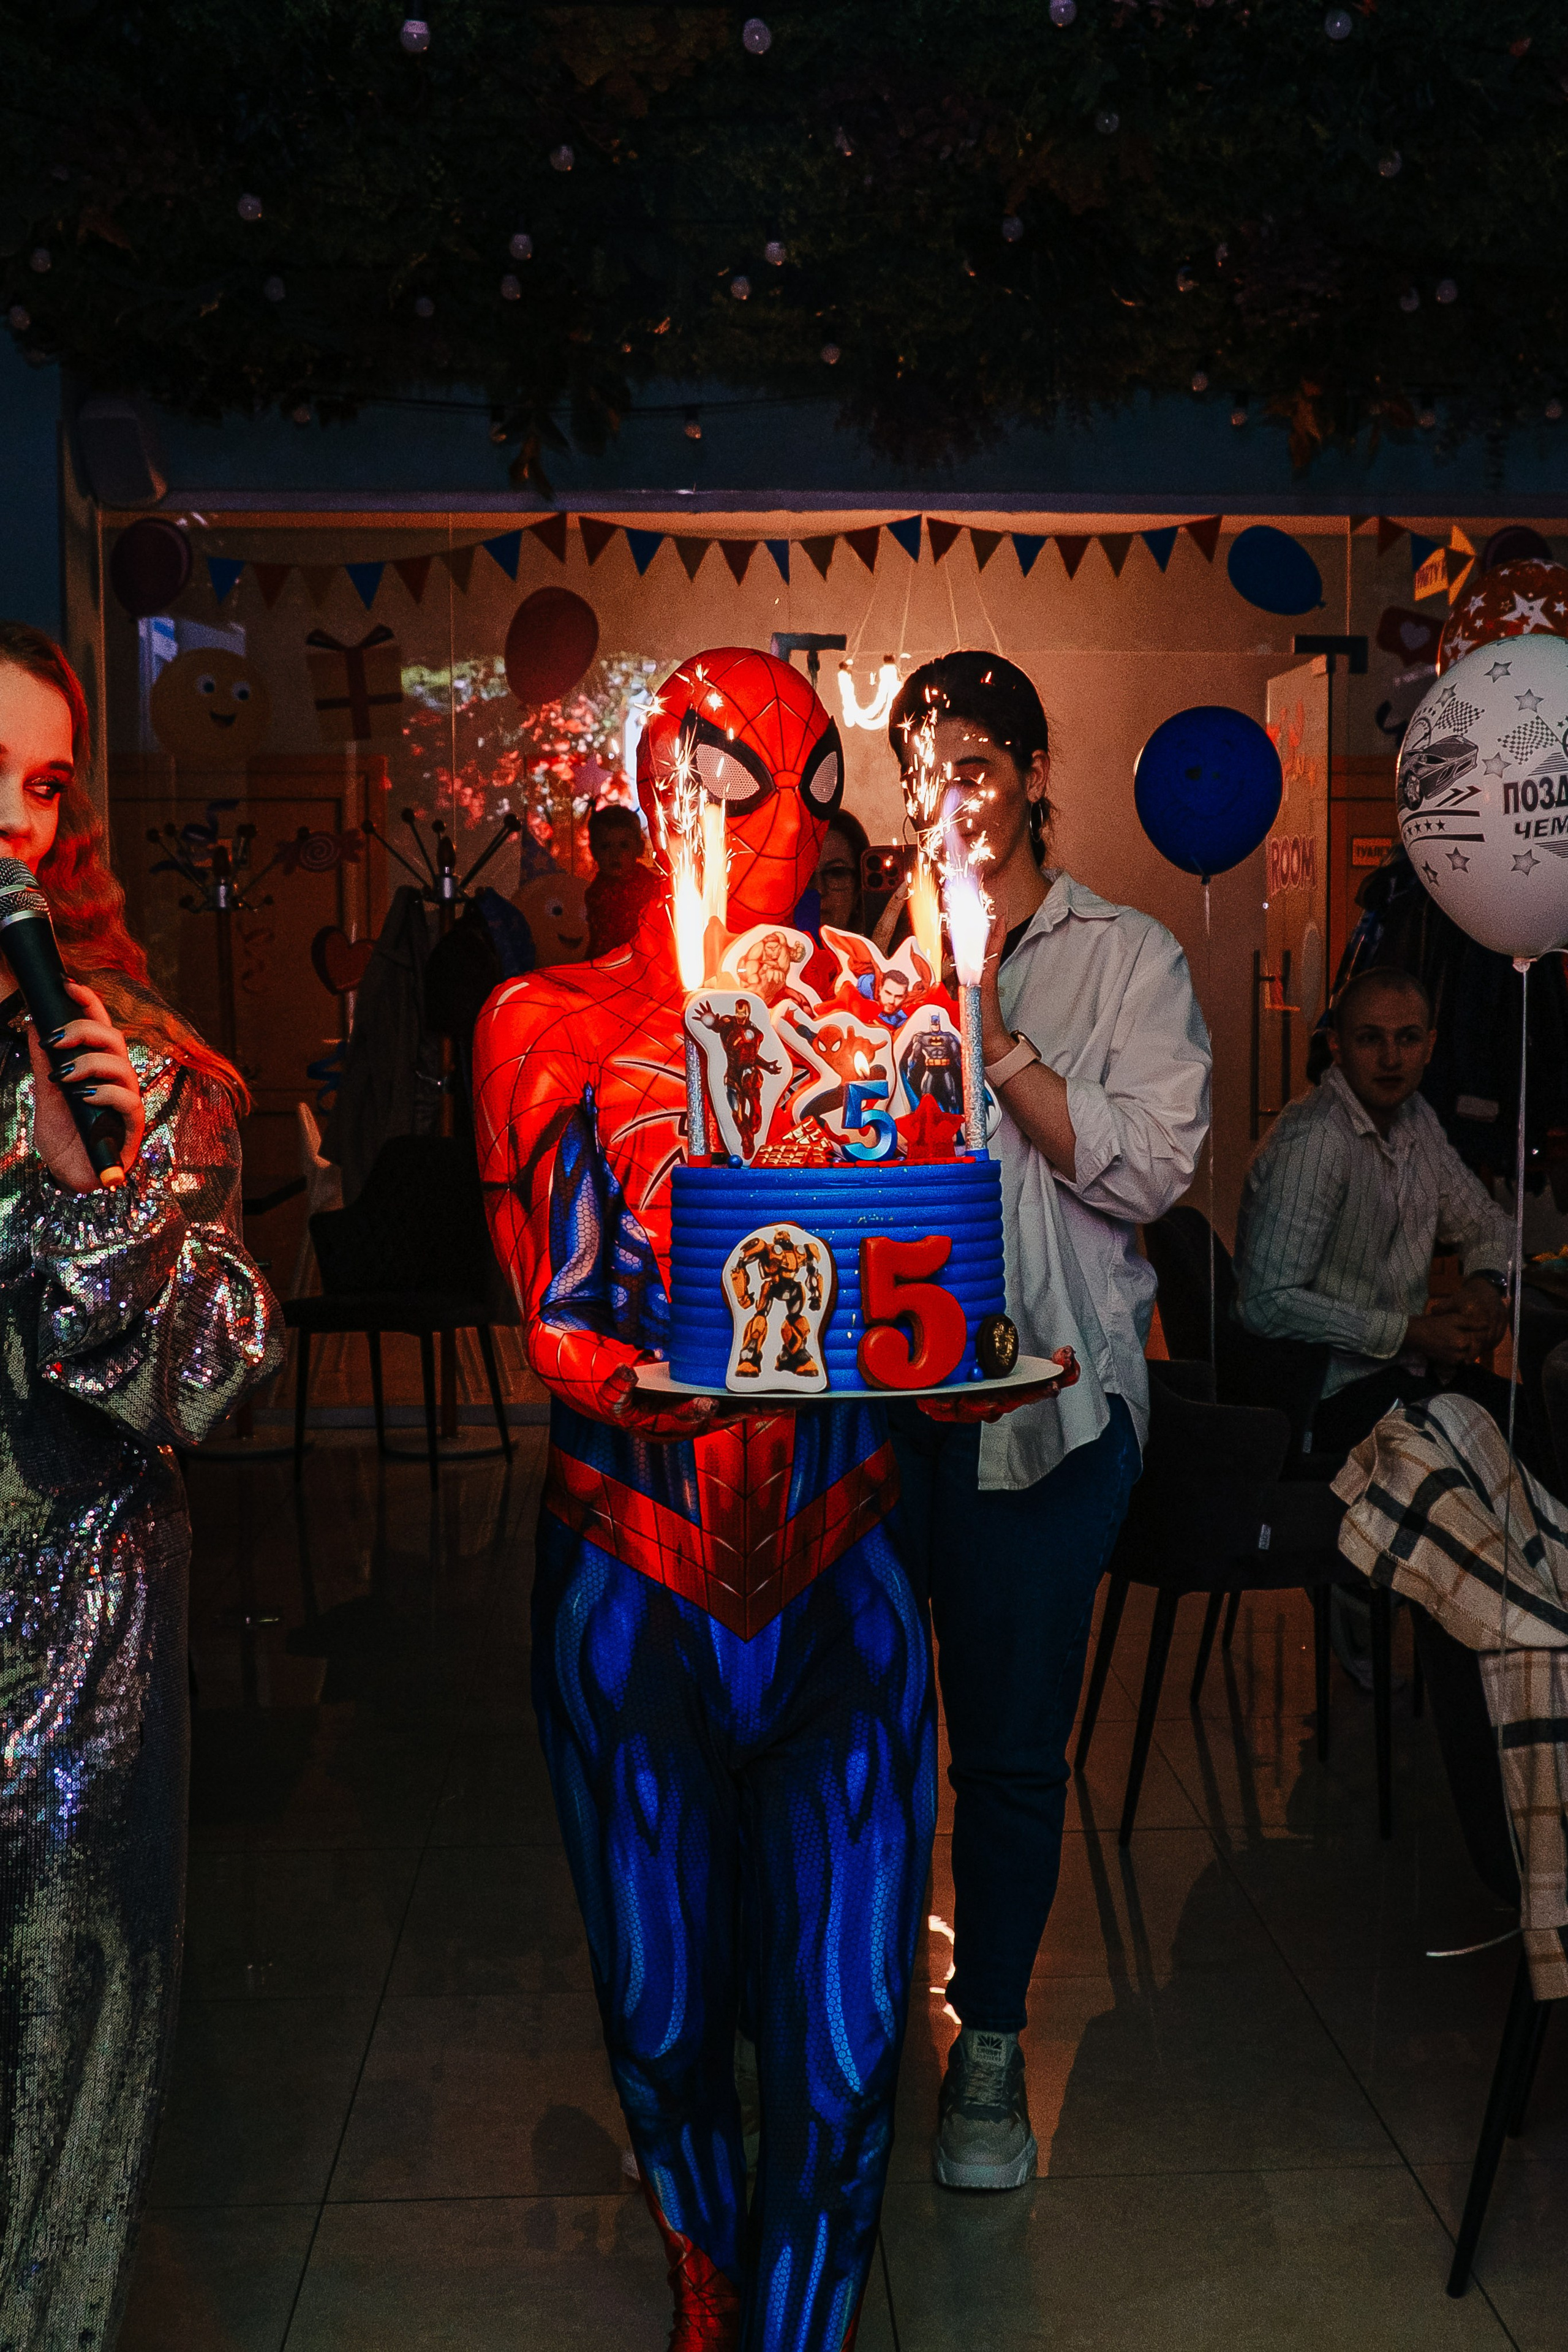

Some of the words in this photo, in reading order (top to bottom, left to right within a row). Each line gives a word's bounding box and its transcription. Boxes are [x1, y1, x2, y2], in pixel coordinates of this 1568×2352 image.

[1515, 816, 1568, 839] ЧЕМ
[1268, 835, 1316, 894] ROOM
[842, 1080, 897, 1162] 5
[857, 1234, 967, 1390] 5
